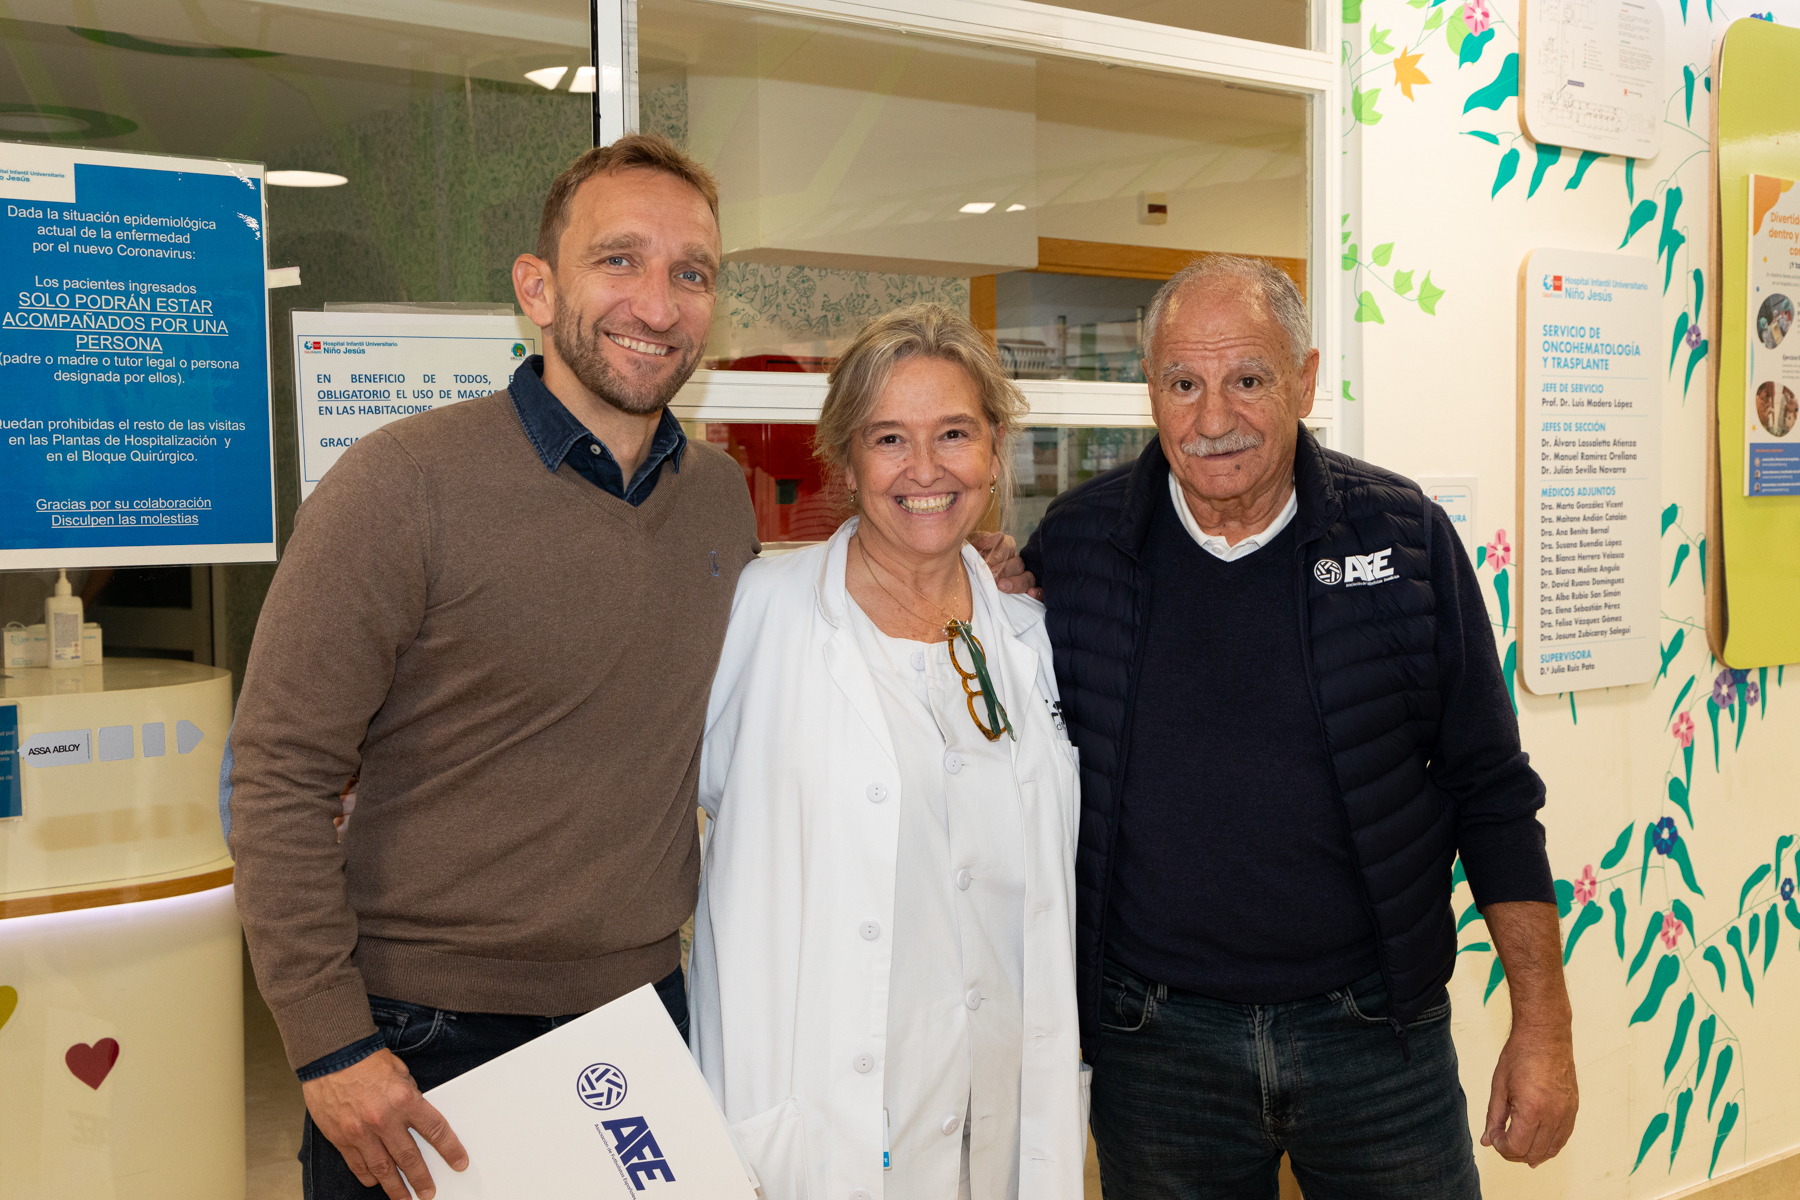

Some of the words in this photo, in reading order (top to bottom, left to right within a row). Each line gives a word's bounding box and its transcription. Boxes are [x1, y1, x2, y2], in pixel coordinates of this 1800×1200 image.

[8, 206, 43, 219] Dada
[48, 208, 58, 220] la
[63, 208, 120, 224] situación
[124, 214, 216, 230] epidemiológica
[38, 224, 76, 238] actual
[81, 227, 96, 238] de
[101, 228, 111, 239] la
[116, 229, 190, 244] enfermedad
[1769, 227, 1793, 240] dentro
[1795, 232, 1799, 244] y
[33, 242, 54, 253] por
[58, 242, 69, 252] el
[74, 244, 112, 255] nuevo
[117, 245, 195, 260] Coronavirus:
[36, 276, 58, 287] Los
[64, 278, 124, 291] pacientes
[129, 280, 196, 295] ingresados
[1565, 276, 1589, 286] Hospital
[1591, 278, 1611, 287] Infantil
[1612, 280, 1648, 290] Universitario
[1565, 287, 1584, 300] Niño
[1587, 289, 1612, 302] Jesús
[19, 292, 70, 307] SOLO
[76, 294, 150, 310] PODRÁN
[156, 299, 212, 314] ESTAR
[2, 312, 145, 331] ACOMPAÑADOS
[151, 319, 188, 332] POR
[194, 321, 228, 334] UNA
[1543, 325, 1586, 338] SERVICIO
[1590, 327, 1600, 338] DE
[76, 335, 162, 350] PERSONA
[1542, 341, 1640, 356] ONCOHEMATOLOGÍA
[46, 356, 53, 364] o
[58, 354, 98, 366] madre
[102, 358, 110, 366] o
[114, 356, 142, 366] tutor
[146, 356, 175, 370] legal
[180, 360, 187, 368] o
[191, 358, 239, 370] persona
[1542, 357, 1548, 368] Y
[1552, 357, 1609, 370] TRASPLANTE
[54, 370, 120, 384] designada
[124, 373, 144, 384] por
[149, 372, 184, 386] ellos).
[317, 374, 331, 383] EN
[351, 374, 405, 384] BENEFICIO
[423, 374, 436, 384] DE
[454, 374, 491, 385] TODOS,
[318, 390, 390, 399] OBLIGATORIO
[397, 390, 407, 398] EL
[413, 390, 433, 399] USO
[440, 390, 452, 399] DE
[1542, 383, 1557, 392] JEFE
[1560, 383, 1568, 392] DE
[1571, 384, 1604, 393] SERVICIO
[319, 406, 333, 415] EN
[336, 406, 355, 415] LAS
[1542, 398, 1558, 406] Prof.
[1561, 398, 1570, 406] Dr.
[1572, 399, 1584, 407] Luis
[1587, 398, 1612, 407] Madero
[1614, 399, 1632, 410] López
[48, 418, 114, 432] prohibidas
[118, 418, 129, 430] el
[134, 420, 164, 430] resto
[168, 419, 183, 430] de
[188, 420, 204, 431] las
[209, 420, 245, 431] visitas
[1542, 422, 1561, 432] JEFES
[1564, 422, 1572, 431] DE
[1575, 420, 1606, 432] SECCIÓN
[9, 436, 24, 446] en
[30, 434, 48, 446] las
[53, 434, 100, 446] Plantas
[104, 434, 120, 446] de
[124, 434, 216, 449] Hospitalización
[224, 438, 231, 448] y
[1542, 439, 1551, 447] Dr.
[1554, 436, 1576, 447] Álvaro
[1613, 438, 1636, 447] Atienza
[47, 452, 62, 462] en
[67, 450, 78, 462] el
[82, 450, 126, 464] Bloque
[130, 450, 198, 464] Quirúrgico.
[1554, 452, 1578, 460] Manuel
[1610, 452, 1637, 460] Orellana
[1576, 465, 1597, 474] Sevilla
[1599, 465, 1626, 473] Navarro
[1541, 485, 1574, 497] MÉDICOS
[1577, 486, 1615, 496] ADJUNTOS
[36, 498, 86, 510] Gracias
[90, 500, 110, 514] por
[114, 500, 129, 510] su
[134, 497, 212, 509] colaboración
[52, 514, 114, 528] Disculpen
[118, 513, 136, 525] las
[140, 512, 198, 524] molestias
[1602, 551, 1624, 559] Velasco
[1344, 548, 1394, 583] AFE
[1552, 579, 1569, 588] David
[1541, 650, 1591, 663] SUPERVISORA
[1551, 665, 1565, 674] Julia
[1568, 664, 1579, 672] Ruiz
[28, 747, 51, 756] ASSA
[53, 744, 80, 753] ABLOY
[594, 1124, 608, 1148] Asociación
[601, 1116, 676, 1191] AFE
